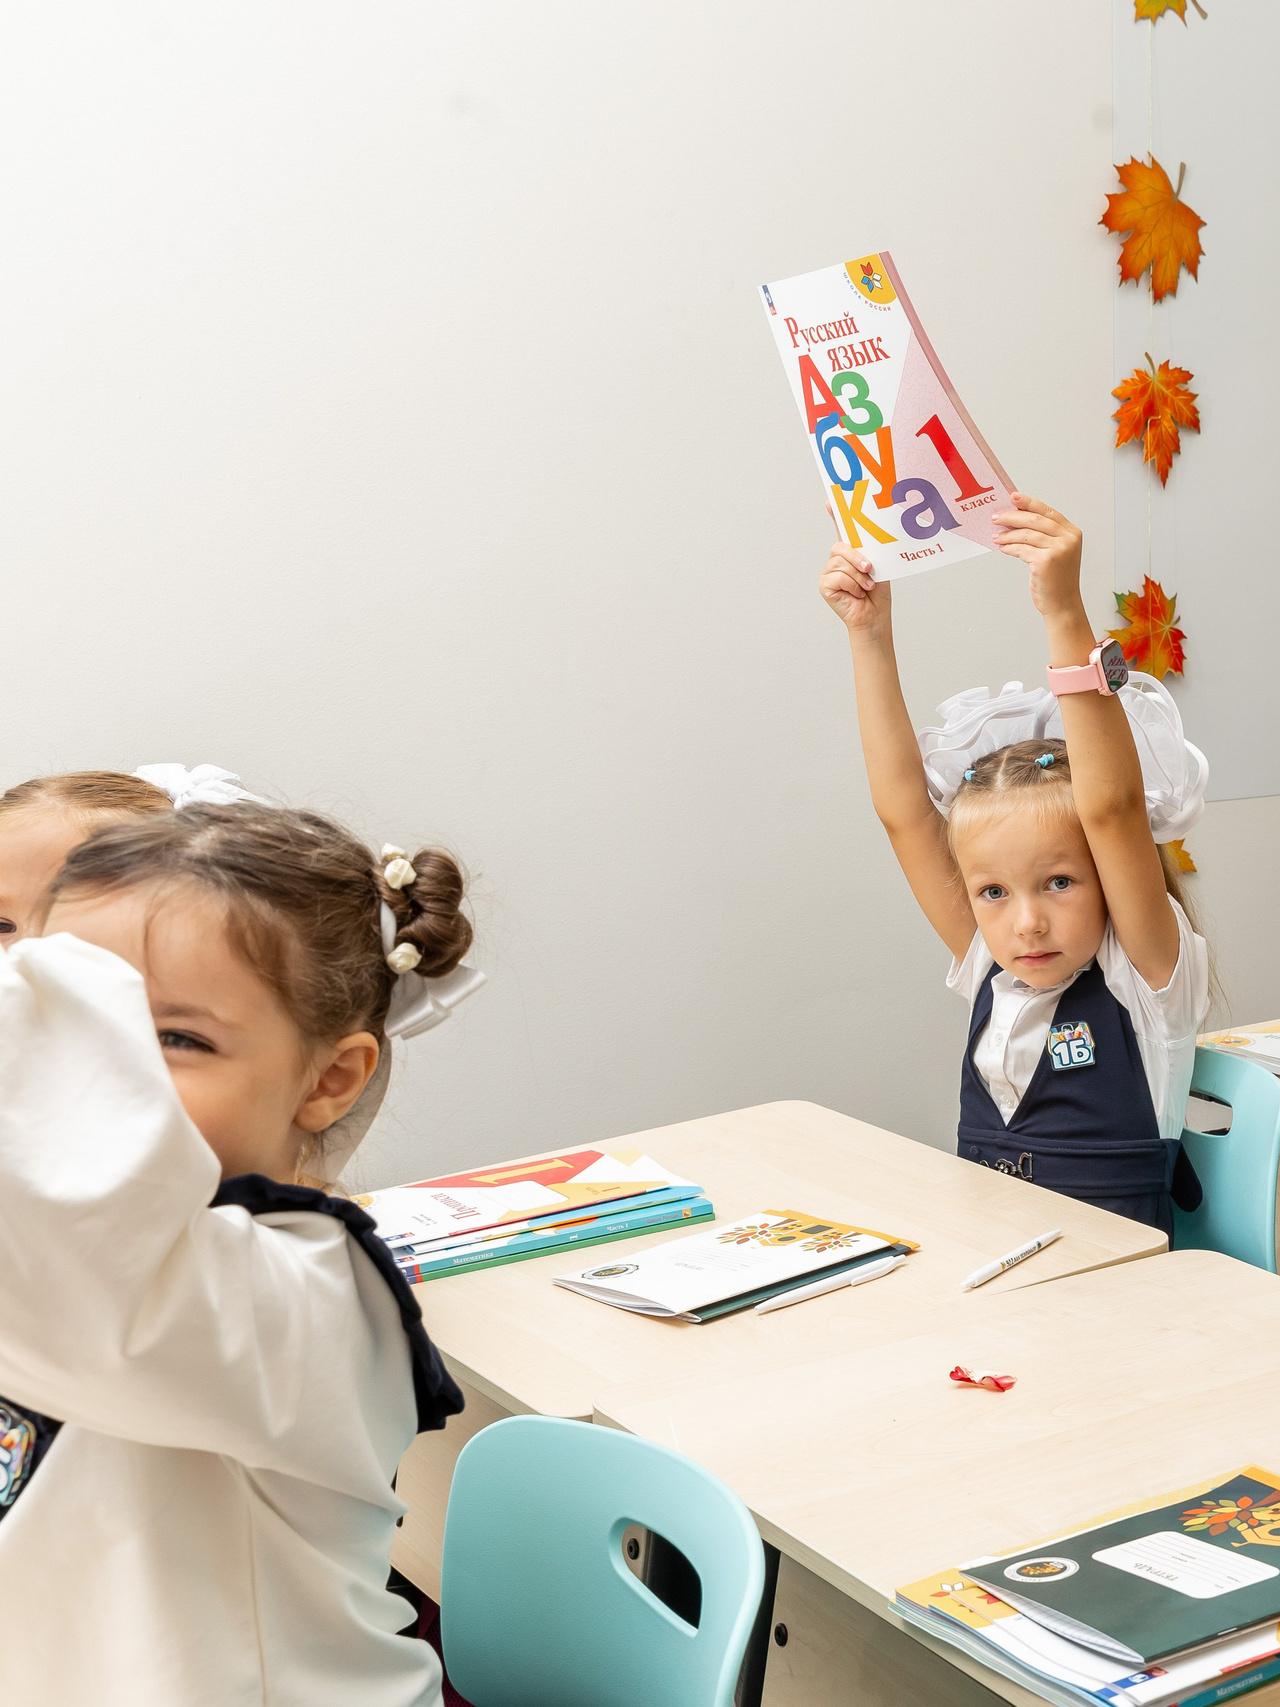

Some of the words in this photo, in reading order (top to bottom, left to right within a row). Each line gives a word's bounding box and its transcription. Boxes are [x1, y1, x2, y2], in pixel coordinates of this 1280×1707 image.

[783, 311, 860, 352] Русский
[915, 414, 995, 503] 1
[960, 492, 998, 513] класс
[899, 547, 936, 564] Часть
[453, 1252, 494, 1264] Математика
[607, 1224, 625, 1232] Часть
[1216, 1672, 1263, 1697] Математика
